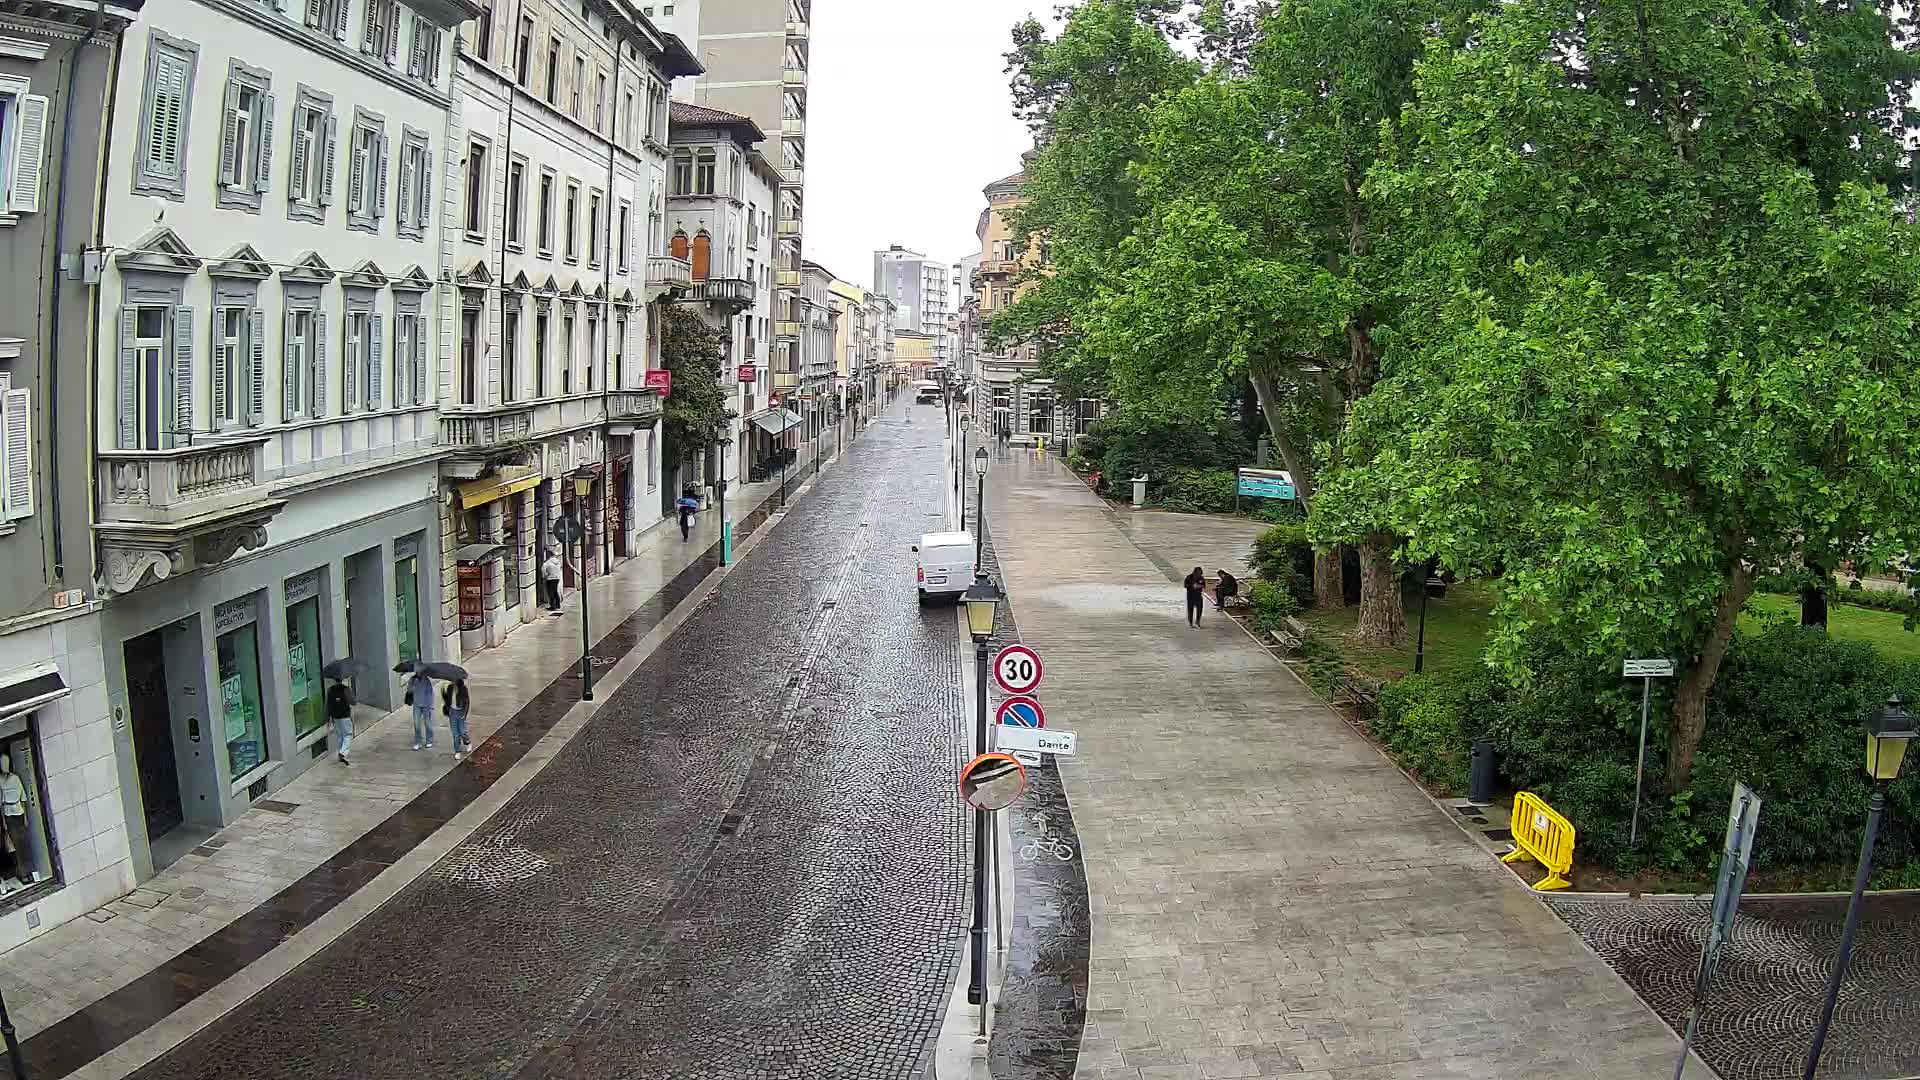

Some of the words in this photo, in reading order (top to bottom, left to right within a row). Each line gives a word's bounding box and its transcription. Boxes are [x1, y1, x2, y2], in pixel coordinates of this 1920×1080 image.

[1006, 659, 1032, 680] 30
[223, 680, 240, 699] 130
[1039, 739, 1069, 749] Dante
